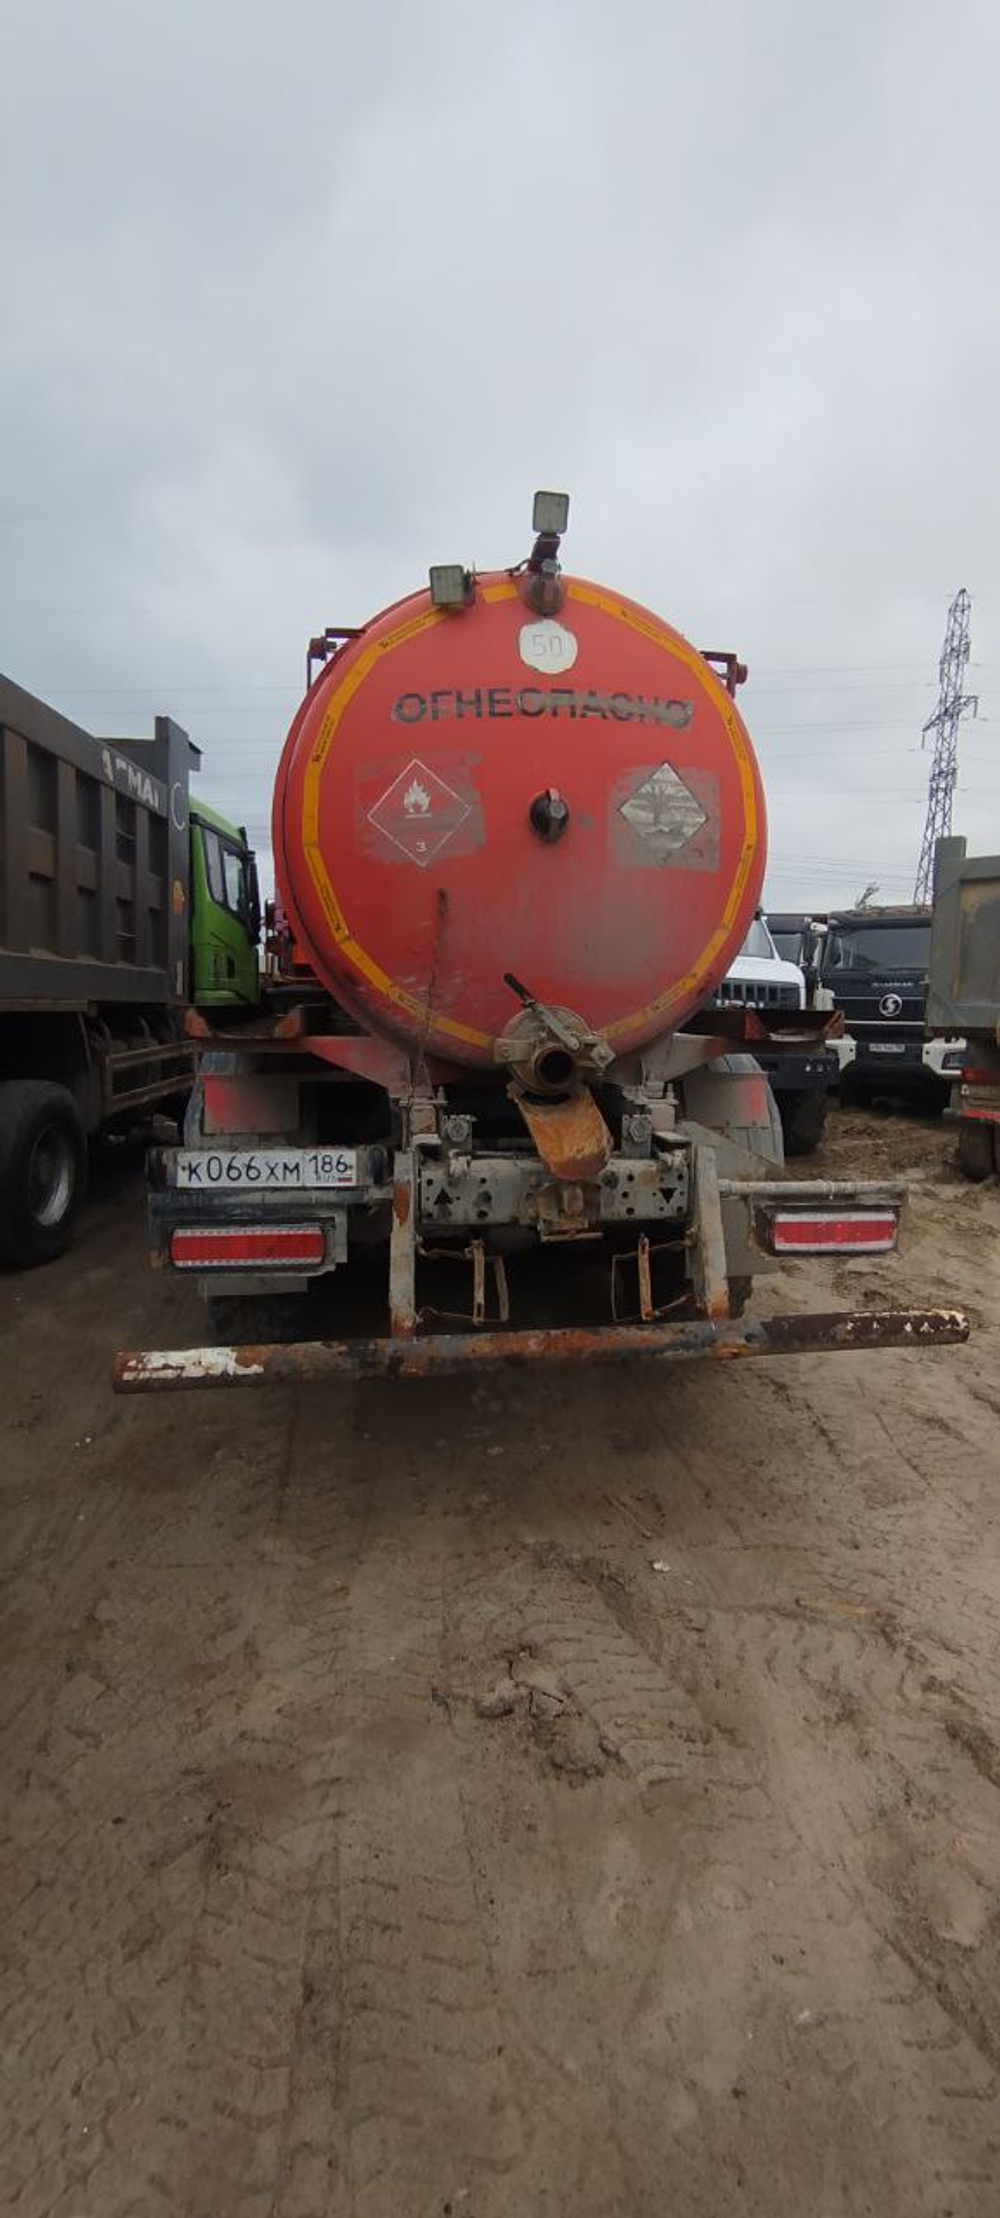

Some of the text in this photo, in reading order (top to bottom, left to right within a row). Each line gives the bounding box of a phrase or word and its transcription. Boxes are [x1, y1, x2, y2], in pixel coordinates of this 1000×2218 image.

[531, 634, 563, 658] 50
[394, 687, 692, 730] ОГНЕОПАСНО
[415, 841, 427, 853] 3
[308, 1154, 349, 1175] 186
